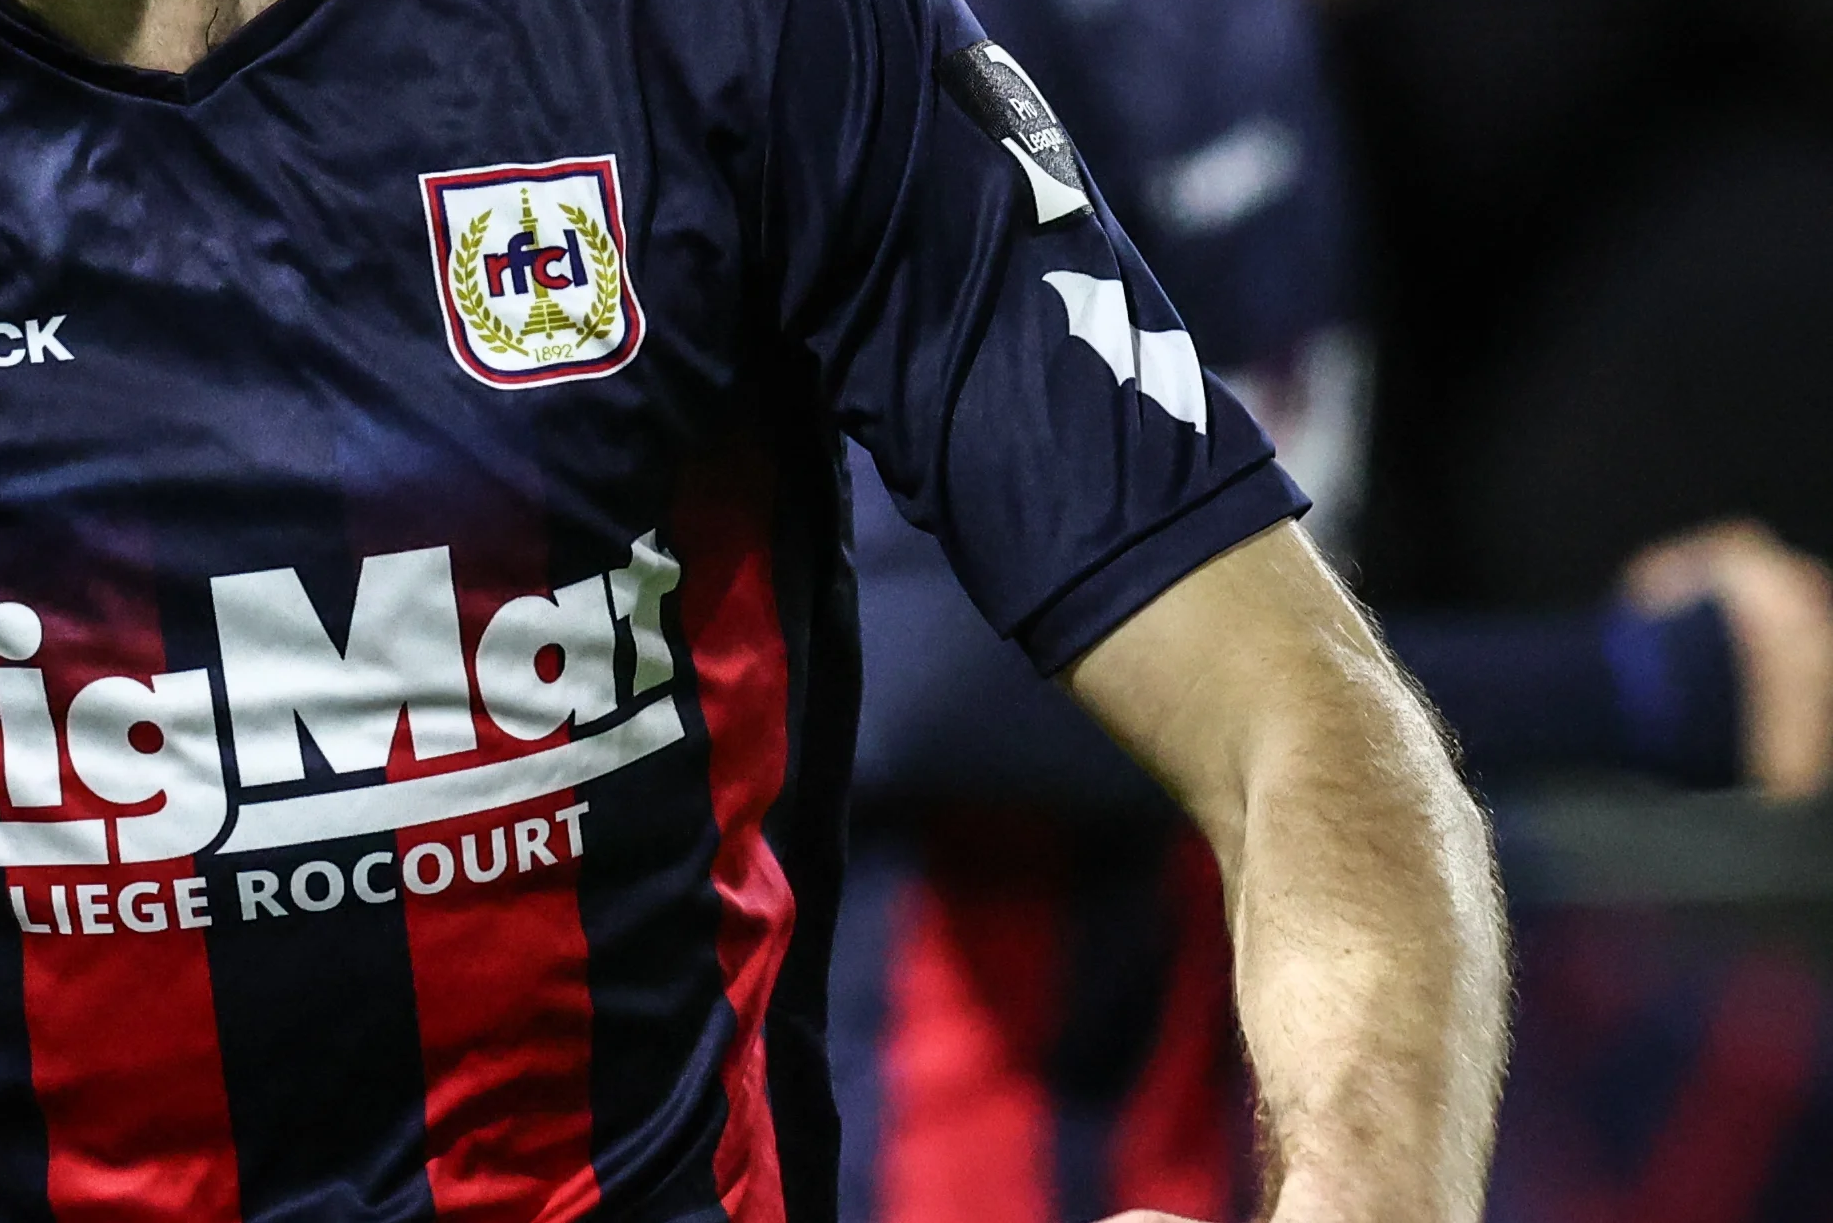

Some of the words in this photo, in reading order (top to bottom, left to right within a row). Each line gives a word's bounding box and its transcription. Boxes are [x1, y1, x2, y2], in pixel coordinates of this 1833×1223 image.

[1008, 97, 1038, 120] Pro
[483, 229, 588, 297] rfcl
[534, 343, 574, 363] 1892
[10, 876, 213, 935] LIEGE
[236, 800, 590, 921] ROCOURT
